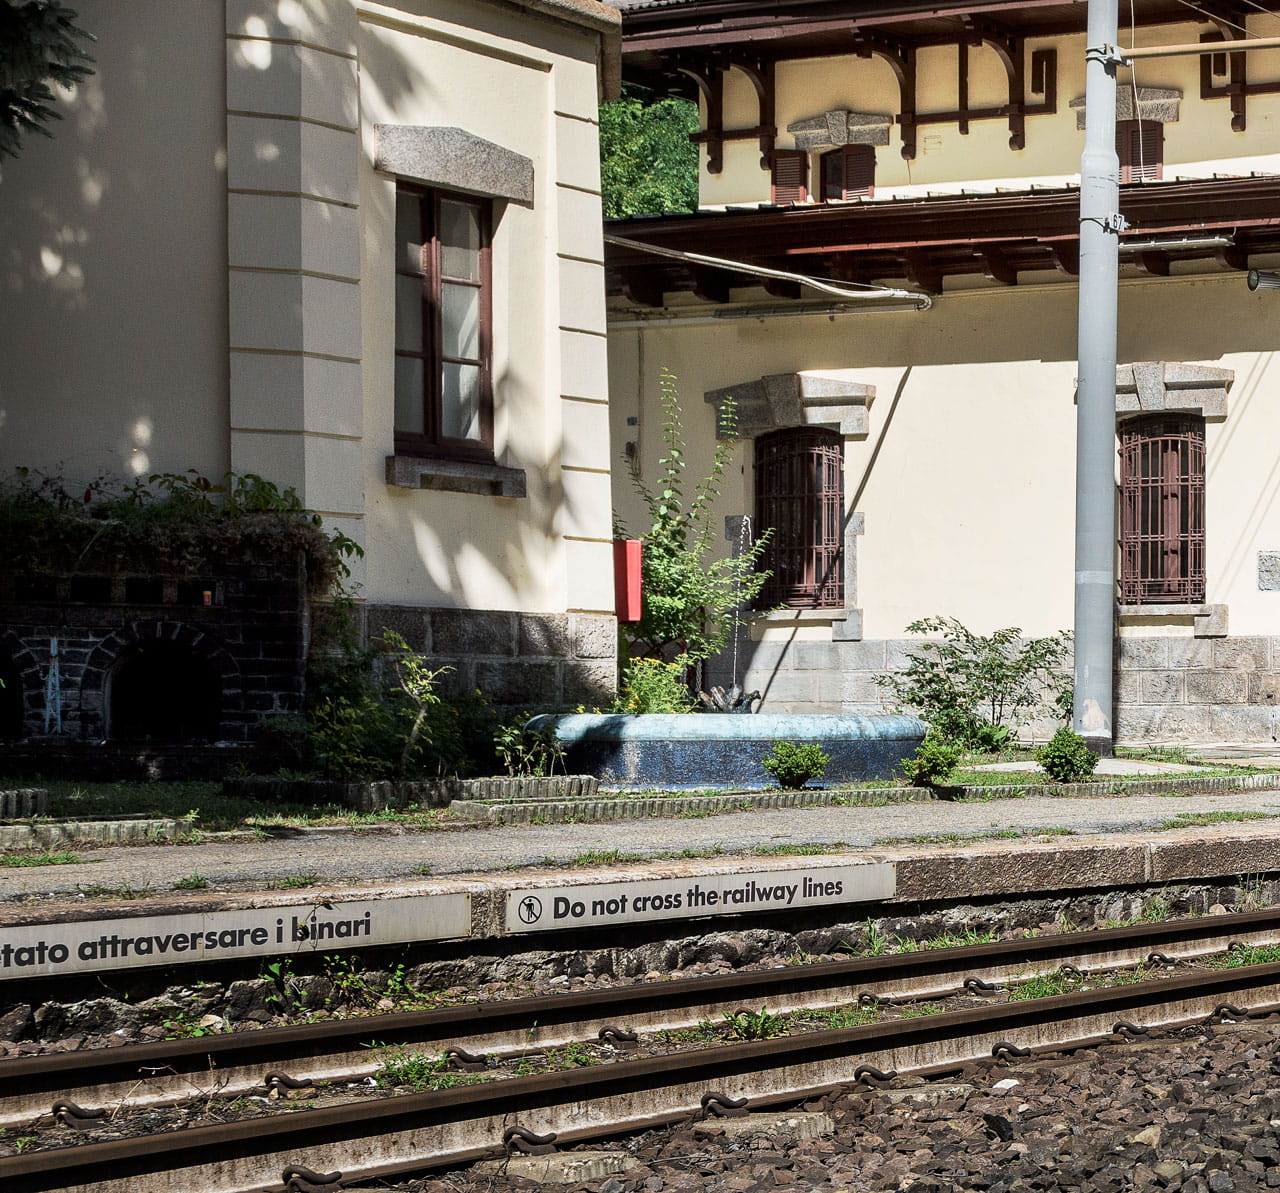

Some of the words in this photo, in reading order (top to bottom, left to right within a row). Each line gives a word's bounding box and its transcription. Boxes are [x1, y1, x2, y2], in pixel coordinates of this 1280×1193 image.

[1112, 213, 1123, 230] 67
[553, 895, 585, 920] Do
[591, 897, 627, 916] not
[632, 894, 683, 912] cross
[686, 884, 718, 908] the
[722, 879, 798, 906] railway
[802, 876, 844, 899] lines
[0, 940, 69, 968] tato
[77, 925, 269, 961] attraversare
[276, 917, 284, 944] i
[291, 911, 371, 943] binari
